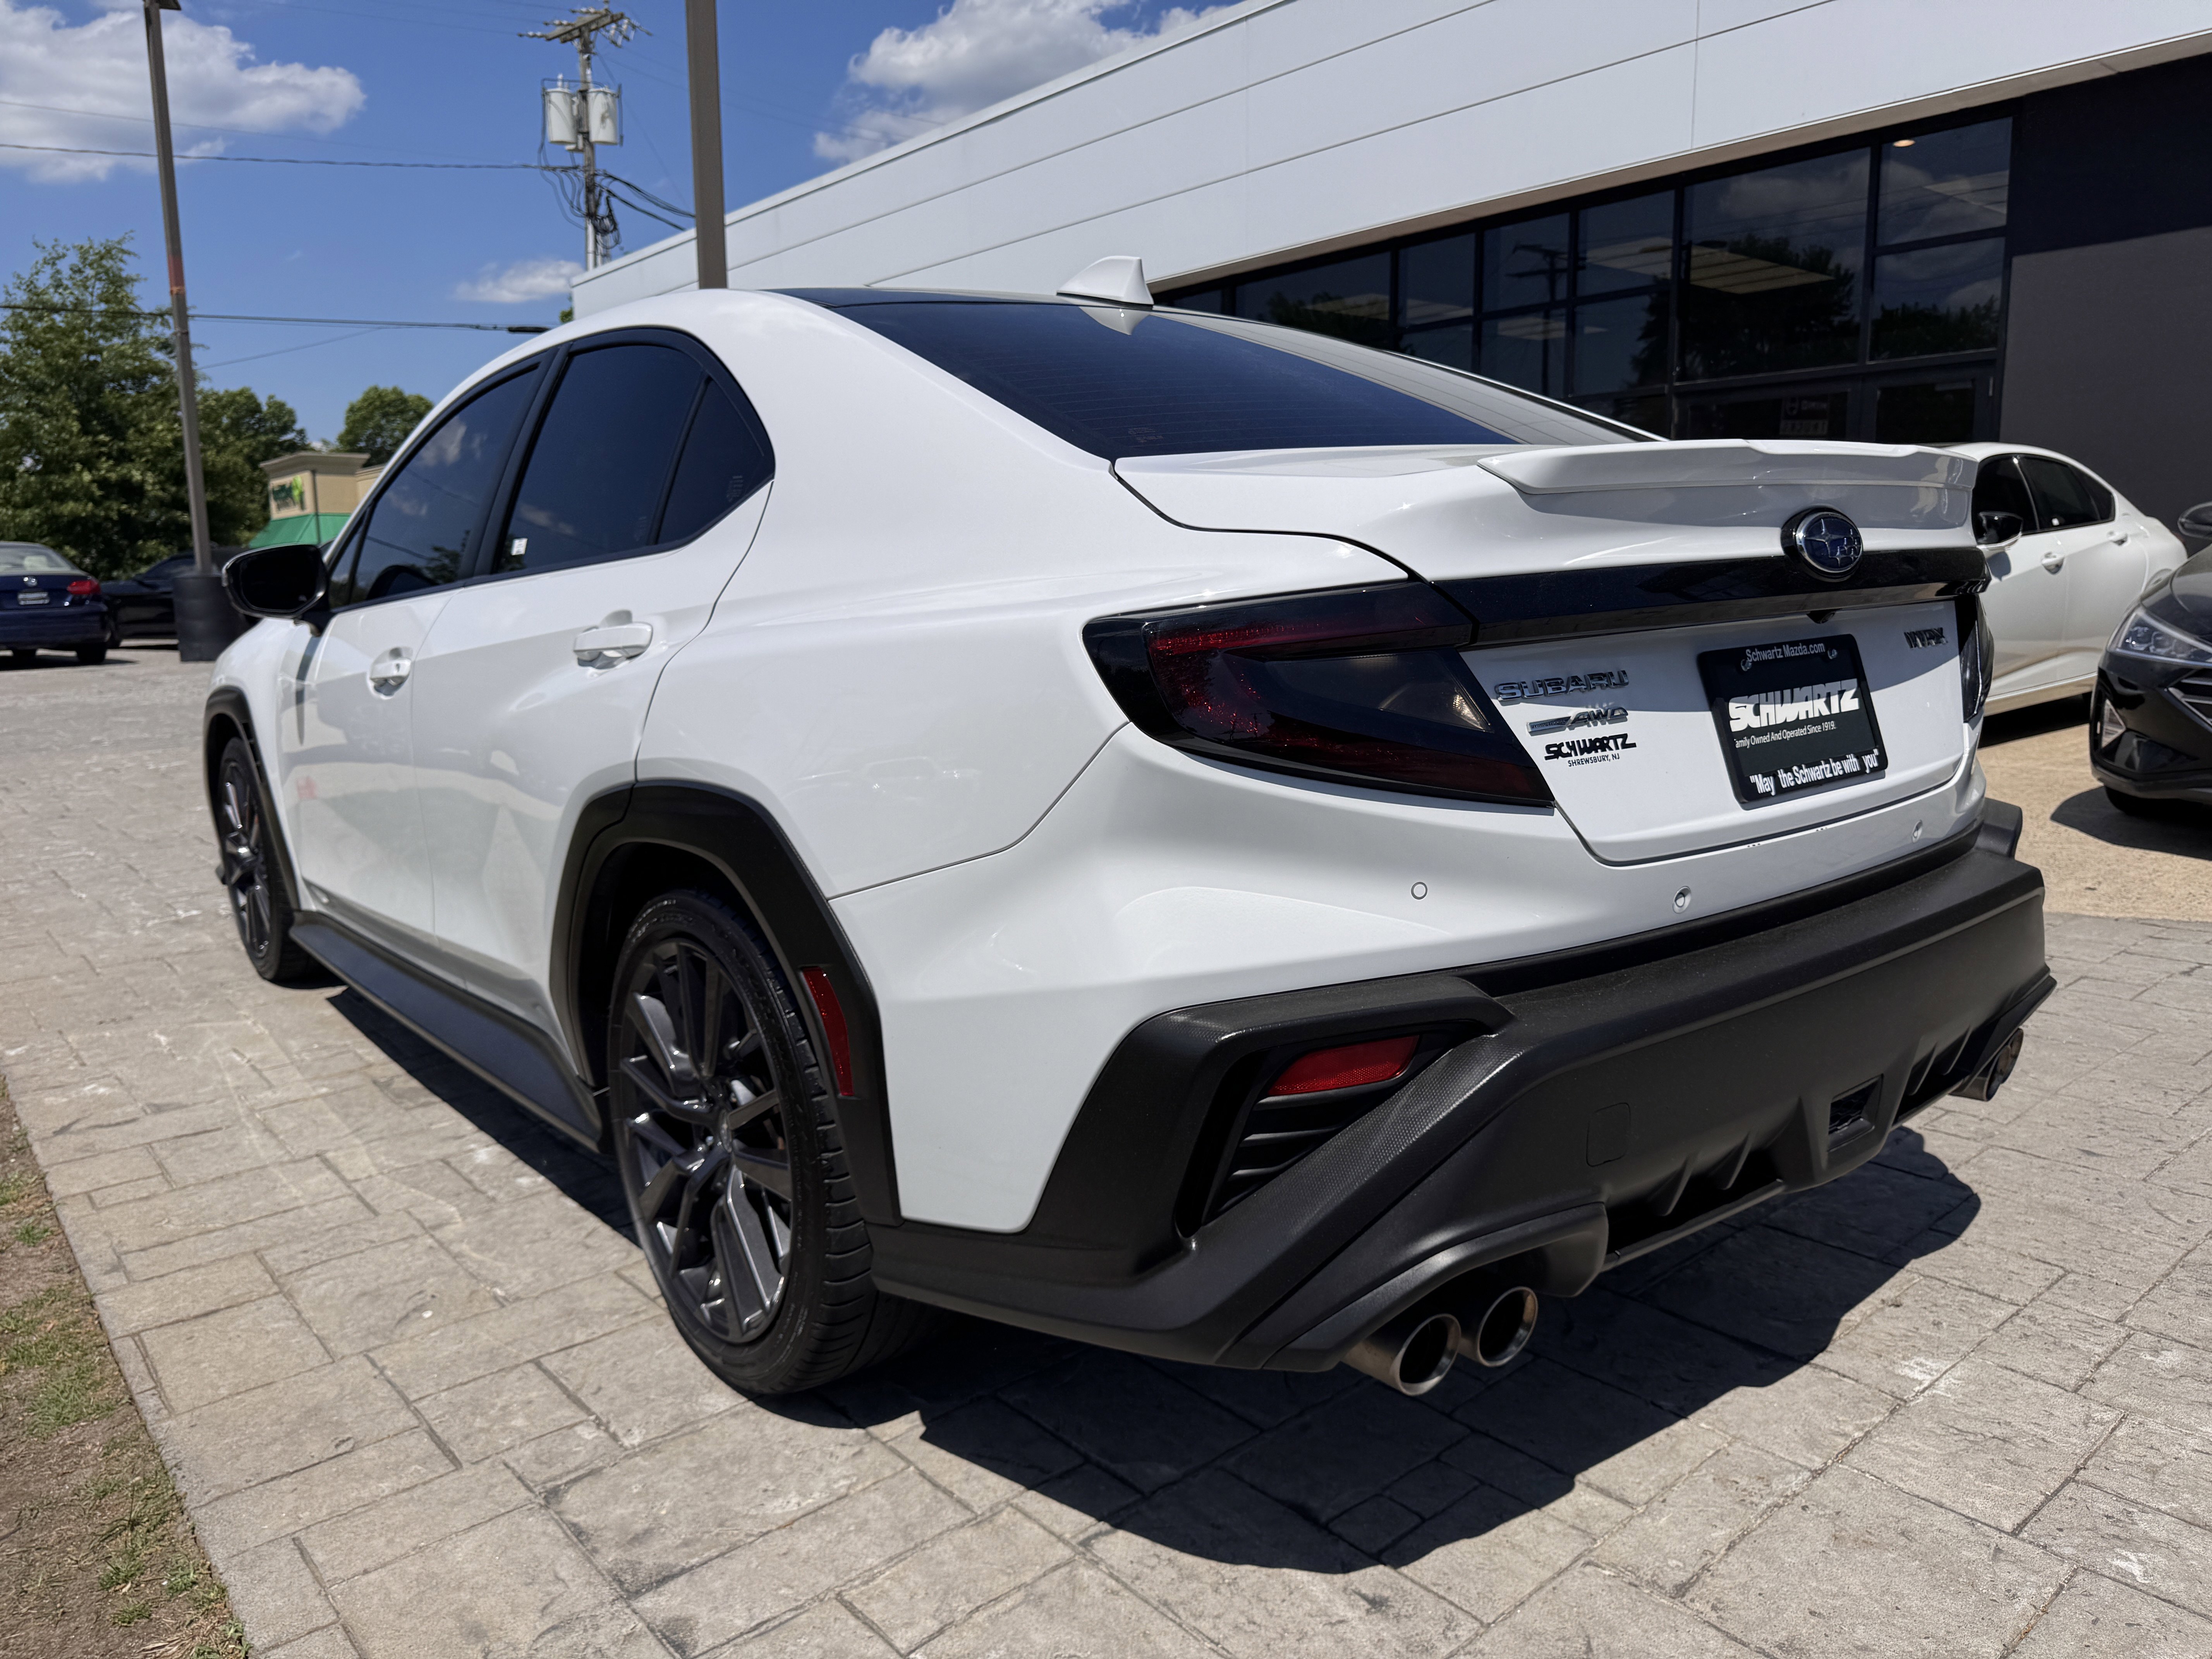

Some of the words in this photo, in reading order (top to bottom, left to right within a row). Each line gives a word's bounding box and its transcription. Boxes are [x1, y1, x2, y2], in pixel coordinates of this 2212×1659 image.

[1746, 646, 1783, 662] Schwartz
[1783, 643, 1826, 658] Mazda.com
[1494, 670, 1629, 701] SUBARU
[1566, 707, 1628, 727] AWD
[1728, 678, 1860, 732] SCHWARTZ
[1544, 733, 1637, 761] SCHWARTZ
[1734, 736, 1750, 749] amily
[1750, 732, 1770, 746] Owned
[1770, 730, 1782, 741] And
[1782, 725, 1807, 740] Operated
[1807, 724, 1822, 734] Since
[1568, 756, 1611, 767] SHREWSBURY,
[1749, 773, 1776, 796] "May
[1777, 769, 1794, 788] the
[1791, 761, 1833, 785] Schwartz
[1829, 758, 1843, 777] be
[1840, 754, 1860, 774] with
[1862, 748, 1879, 774] you"
